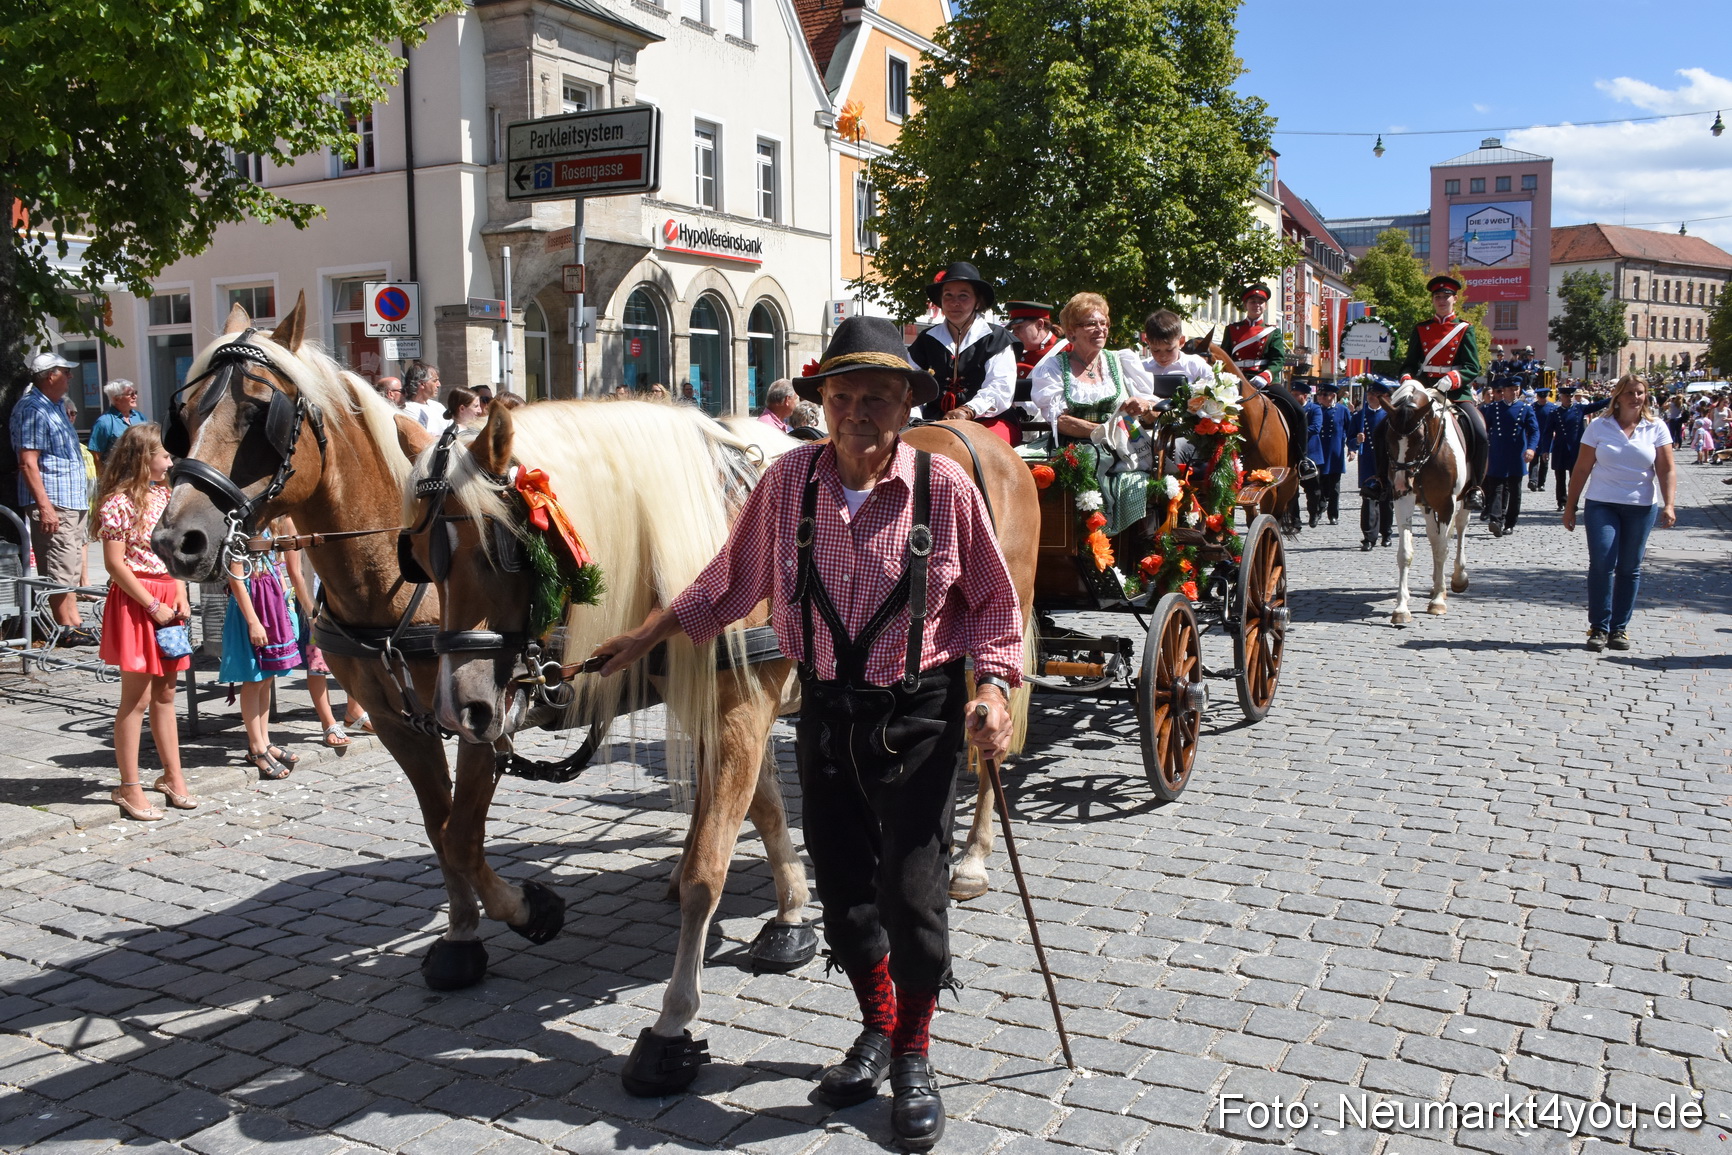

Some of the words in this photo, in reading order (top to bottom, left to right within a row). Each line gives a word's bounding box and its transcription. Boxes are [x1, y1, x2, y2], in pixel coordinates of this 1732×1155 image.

[530, 123, 623, 149] Parkleitsystem
[562, 163, 623, 181] Rosengasse
[548, 234, 572, 248] Rosengass
[680, 223, 762, 254] HypoVereinsbank
[1465, 276, 1522, 287] sgezeichnet!
[1285, 267, 1293, 331] ACKEREI
[379, 323, 407, 333] ZONE
